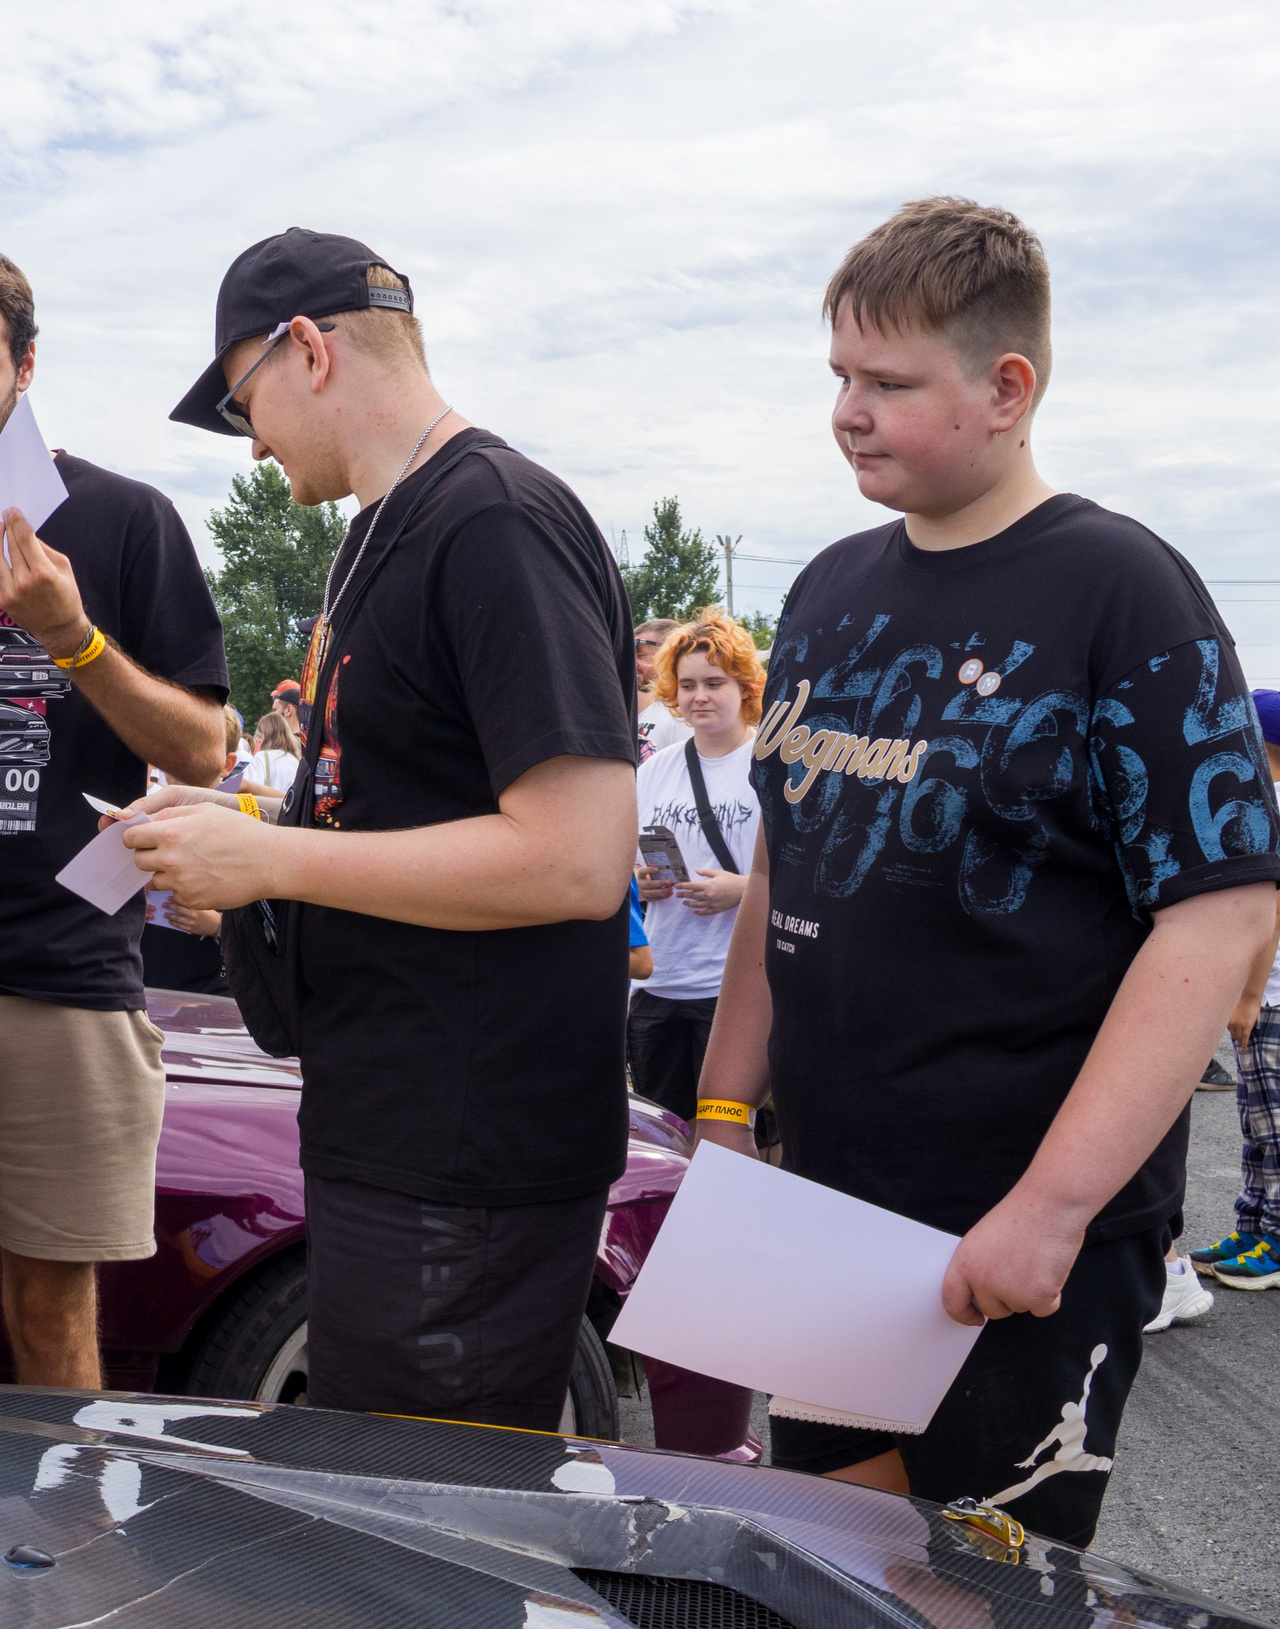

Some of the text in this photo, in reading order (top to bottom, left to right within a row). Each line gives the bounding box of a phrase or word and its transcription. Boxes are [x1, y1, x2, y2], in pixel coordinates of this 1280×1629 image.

[751, 679, 928, 804] Wegmans
[784, 914, 820, 940] DREAMS
[715, 1105, 743, 1117] ПЛЮС
